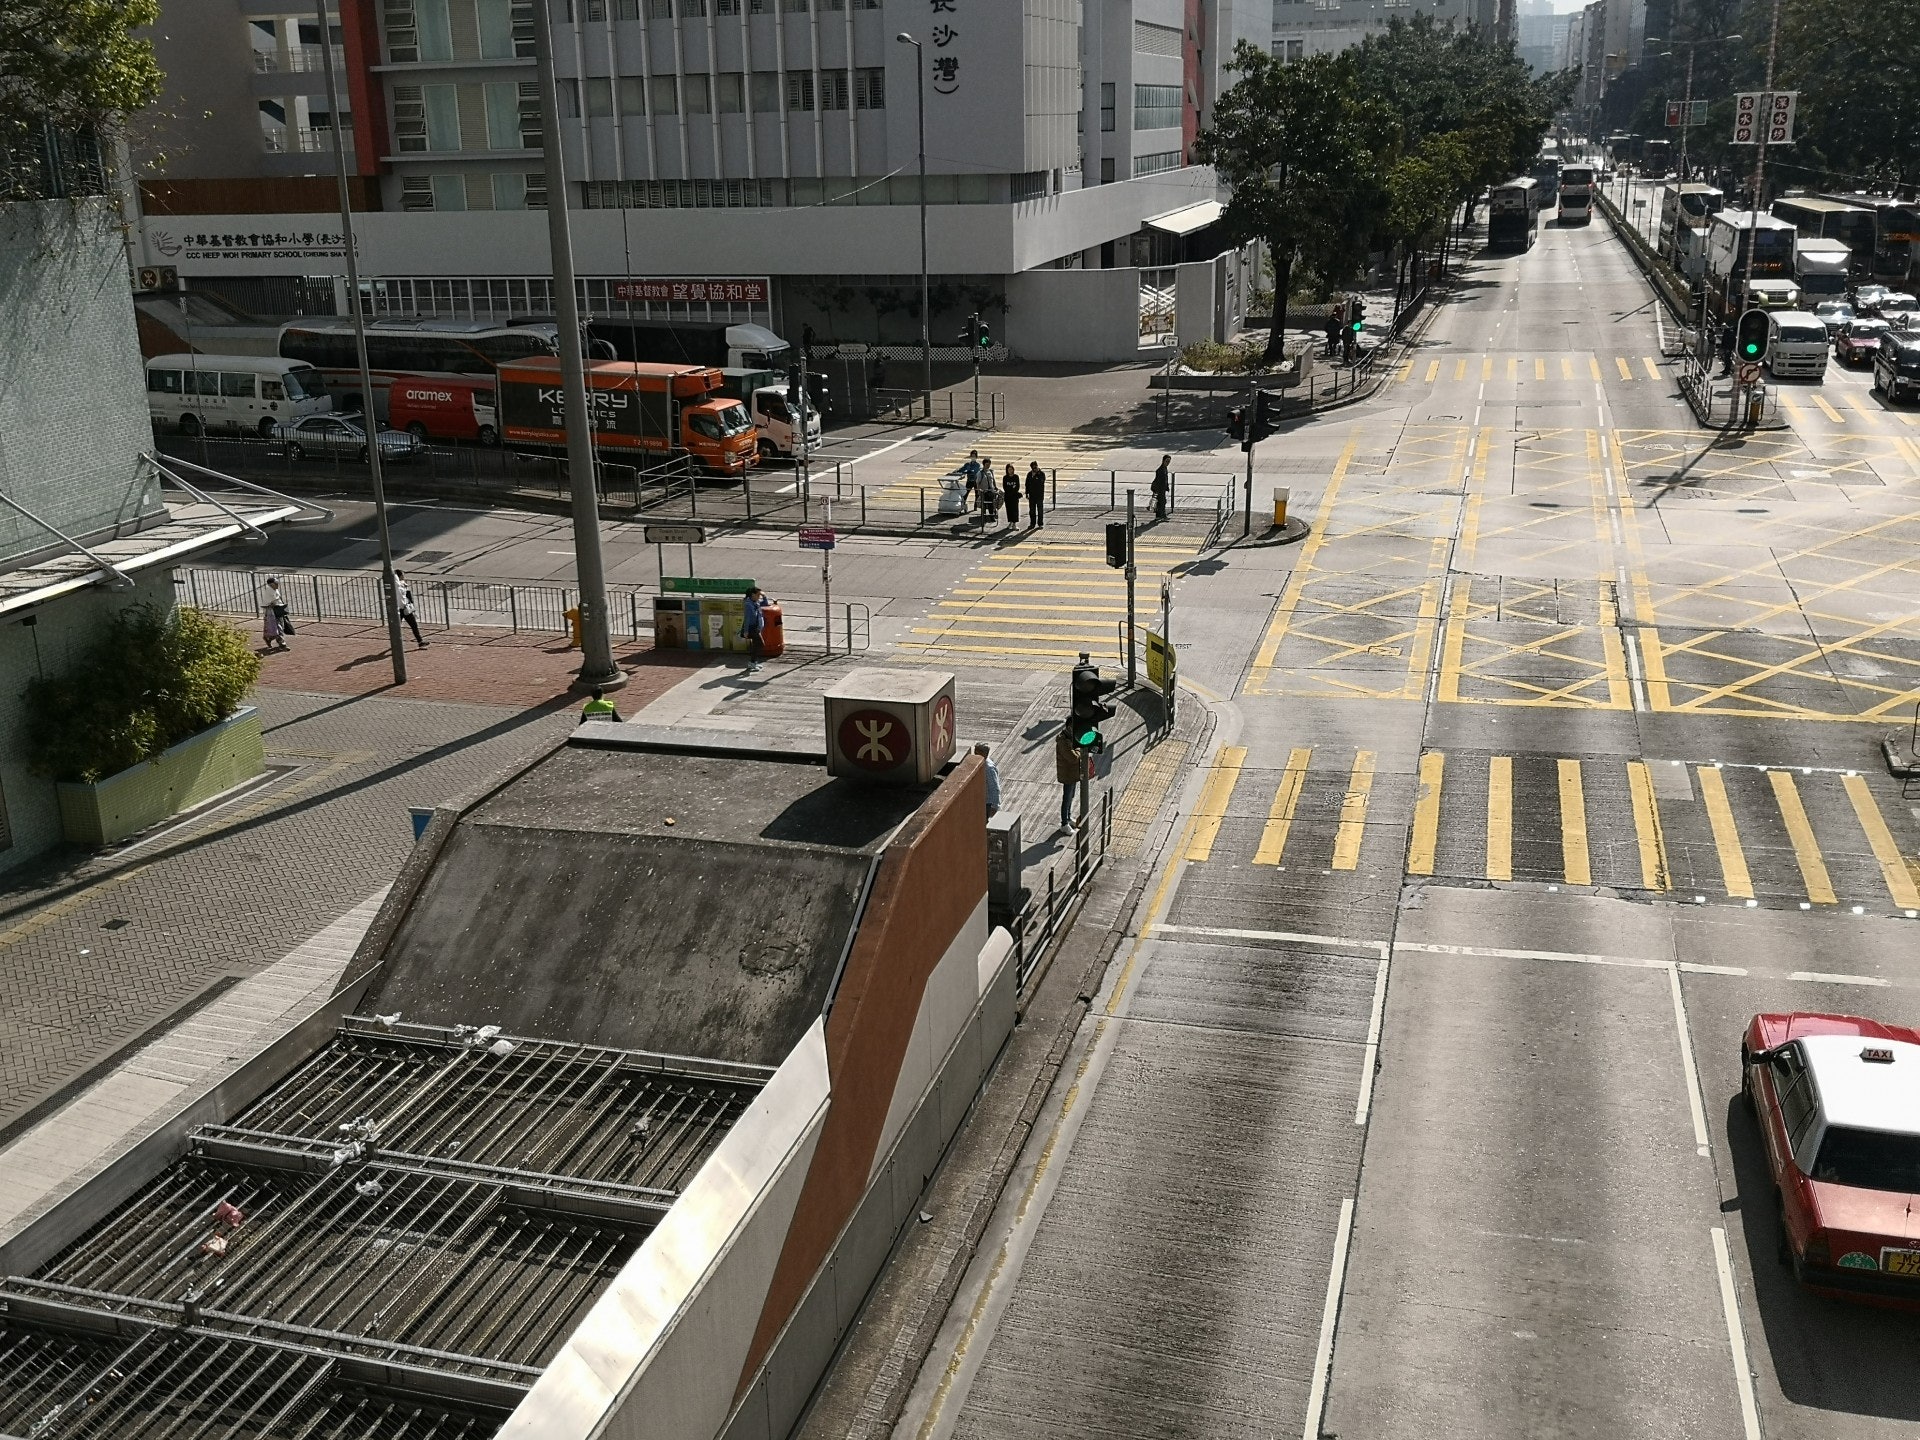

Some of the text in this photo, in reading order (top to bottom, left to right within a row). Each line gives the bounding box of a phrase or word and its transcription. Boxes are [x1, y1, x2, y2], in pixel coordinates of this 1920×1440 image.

[241, 251, 271, 259] PRIMARY
[274, 250, 302, 258] SCHOOL
[672, 283, 761, 301] 望覺協和堂
[406, 390, 452, 402] aramex
[1867, 1049, 1893, 1058] TAXI
